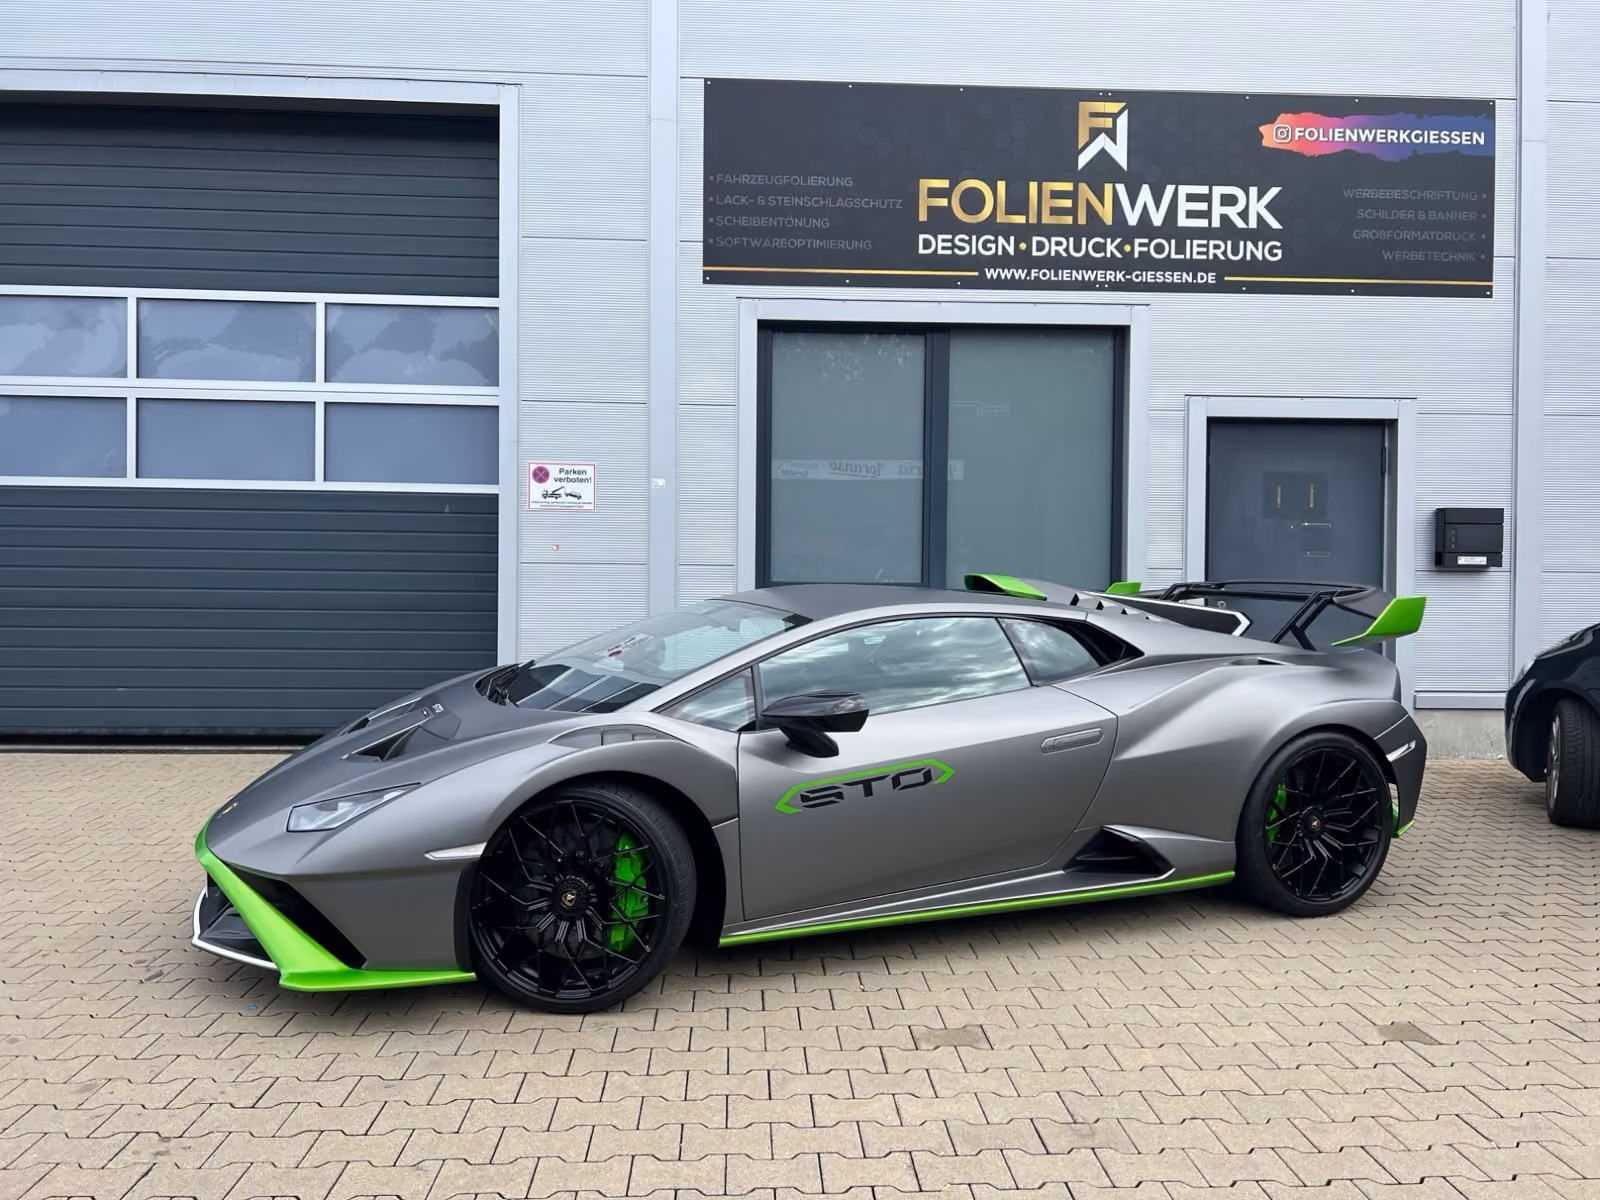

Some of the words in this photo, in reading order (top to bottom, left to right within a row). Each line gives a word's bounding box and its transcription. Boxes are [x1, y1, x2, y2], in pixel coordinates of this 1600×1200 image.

[1294, 127, 1485, 146] FOLIENWERKGIESSEN
[715, 173, 853, 187] FAHRZEUGFOLIERUNG
[716, 194, 754, 206] LACK-
[768, 196, 903, 209] STEINSCHLAGSCHUTZ
[1343, 188, 1478, 201] WERBEBESCHRIFTUNG
[918, 178, 1283, 229] FOLIENWERK
[1356, 208, 1415, 220] SCHILDER
[1428, 210, 1477, 221] BANNER
[715, 215, 830, 229] SCHEIBENTÖNUNG
[715, 237, 873, 251] SOFTWAREOPTIMIERUNG
[918, 233, 1015, 256] DESIGN
[1031, 236, 1123, 259] DRUCK
[1133, 238, 1283, 262] FOLIERUNG
[1382, 250, 1476, 262] WERBETECHNIK
[984, 267, 1217, 284] WWW.FOLIENWERK-GIESSEN.DE
[559, 467, 587, 476] Parken
[553, 476, 592, 484] verboten!
[799, 766, 933, 809] STO
